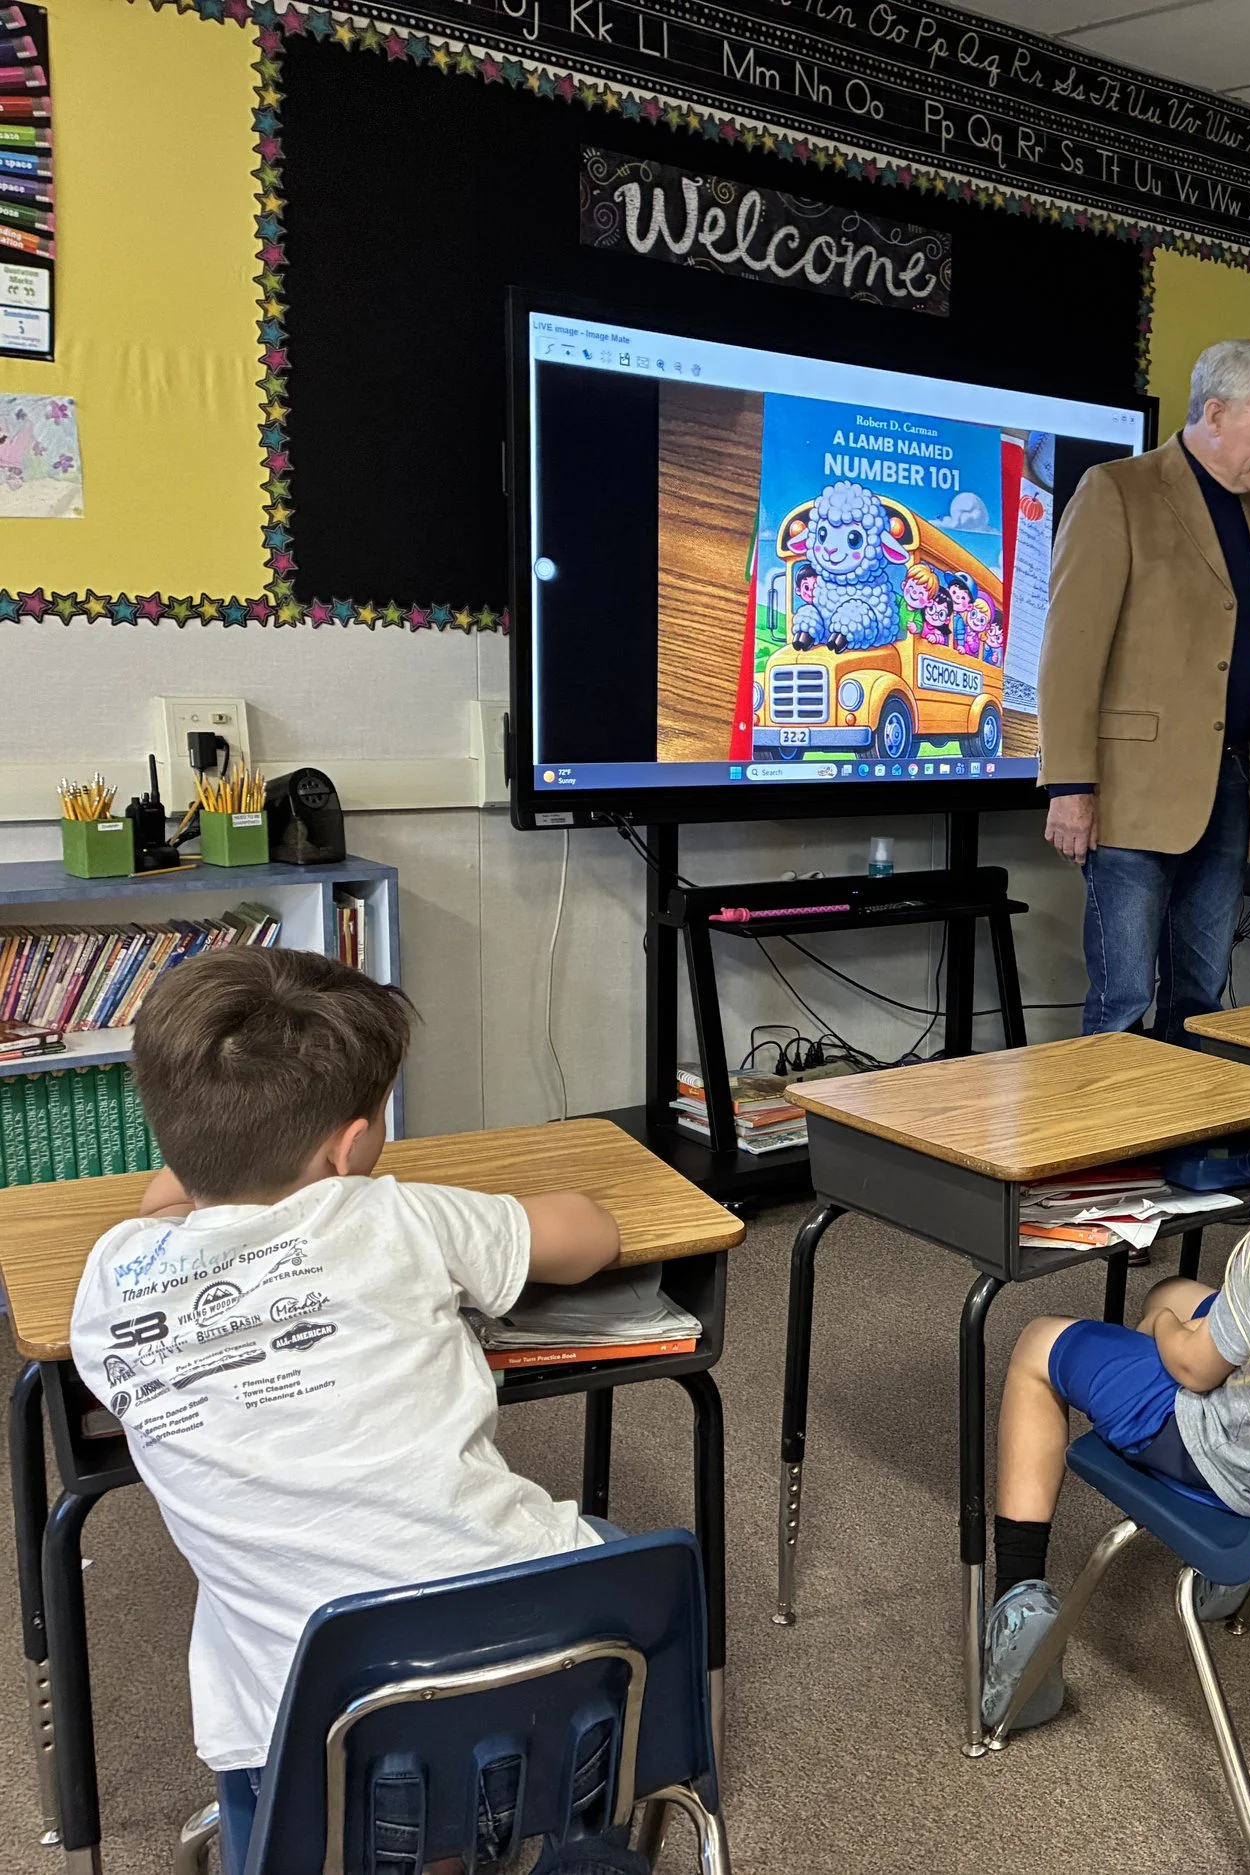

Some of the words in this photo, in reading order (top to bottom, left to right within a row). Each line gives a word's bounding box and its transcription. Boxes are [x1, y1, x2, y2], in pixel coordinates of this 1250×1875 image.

[868, 3, 909, 43] Oo
[914, 16, 949, 69] Pp
[957, 32, 1001, 87] Qq
[1010, 47, 1044, 89] Rr
[1052, 67, 1086, 101] Ss
[1089, 76, 1121, 113] Tt
[1126, 86, 1162, 127] Uu
[1168, 98, 1203, 136] Vv
[1205, 110, 1244, 148] Ww
[570, 0, 613, 43] Kk
[723, 40, 780, 90] Mm
[795, 60, 832, 106] Nn
[845, 79, 884, 119] Oo
[924, 100, 954, 153] Pp
[967, 114, 1006, 169] Qq
[1017, 128, 1043, 164] Rr
[1060, 140, 1084, 175] Ss
[1096, 149, 1121, 185] Tt
[1134, 163, 1162, 197] Uu
[1174, 171, 1199, 205] Vv
[1207, 179, 1241, 217] Ww
[613, 176, 937, 298] Welcome
[532, 320, 553, 332] LIVE
[555, 325, 579, 338] image
[611, 333, 631, 345] Mate
[856, 414, 888, 431] Robert
[889, 419, 901, 432] D.
[903, 421, 938, 437] Carman
[833, 430, 846, 446] A
[849, 432, 894, 452] LAMB
[897, 440, 954, 461] NAMED
[824, 452, 924, 487] NUMBER
[929, 466, 961, 491] 101
[925, 663, 960, 688] SCHOOL
[962, 672, 979, 690] BUS
[558, 777, 577, 785] Sunny
[122, 1282, 158, 1302] Thank
[161, 1275, 188, 1293] you
[193, 1269, 208, 1280] to
[212, 1258, 235, 1274] our
[262, 1271, 290, 1286] MEYER
[292, 1266, 324, 1278] RANCH
[177, 1309, 207, 1326] VIKING
[196, 1325, 227, 1343] BUTTE
[230, 1315, 262, 1331] BASIN
[275, 1325, 333, 1348] ALL-AMERICAN
[537, 1354, 561, 1362] Practice
[561, 1352, 577, 1360] Book
[135, 1379, 166, 1400] LARSON
[242, 1375, 275, 1388] Fleming
[276, 1368, 302, 1382] Family
[242, 1388, 264, 1399] Town
[265, 1380, 301, 1394] Cleaners
[245, 1400, 258, 1410] Dry
[259, 1391, 295, 1406] Cleaning
[305, 1379, 336, 1394] Laundry
[165, 1406, 188, 1418] Dance
[168, 1411, 200, 1427] Partners
